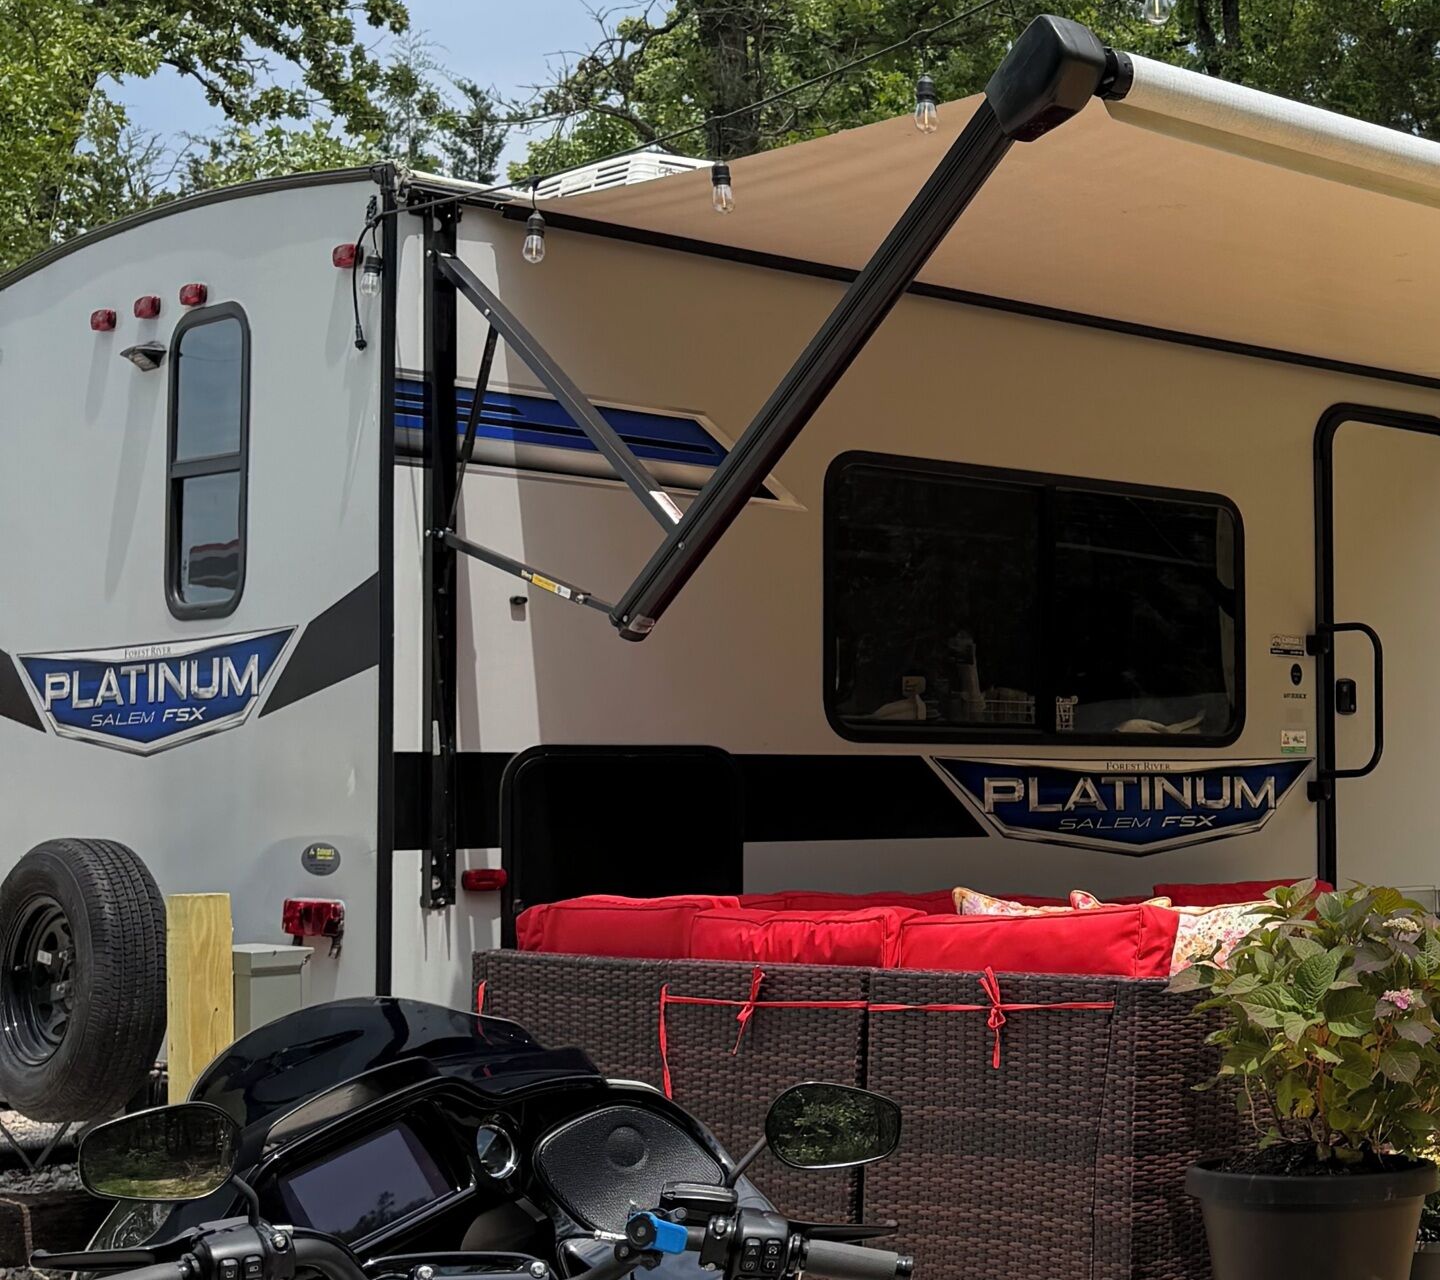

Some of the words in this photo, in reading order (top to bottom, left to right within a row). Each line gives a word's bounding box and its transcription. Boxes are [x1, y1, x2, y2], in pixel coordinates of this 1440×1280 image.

[45, 654, 260, 712] PLATINUM
[91, 711, 155, 727] SALEM
[162, 706, 206, 723] FSX
[983, 775, 1277, 814] PLATINUM
[1058, 816, 1151, 831] SALEM
[1161, 814, 1217, 829] FSX
